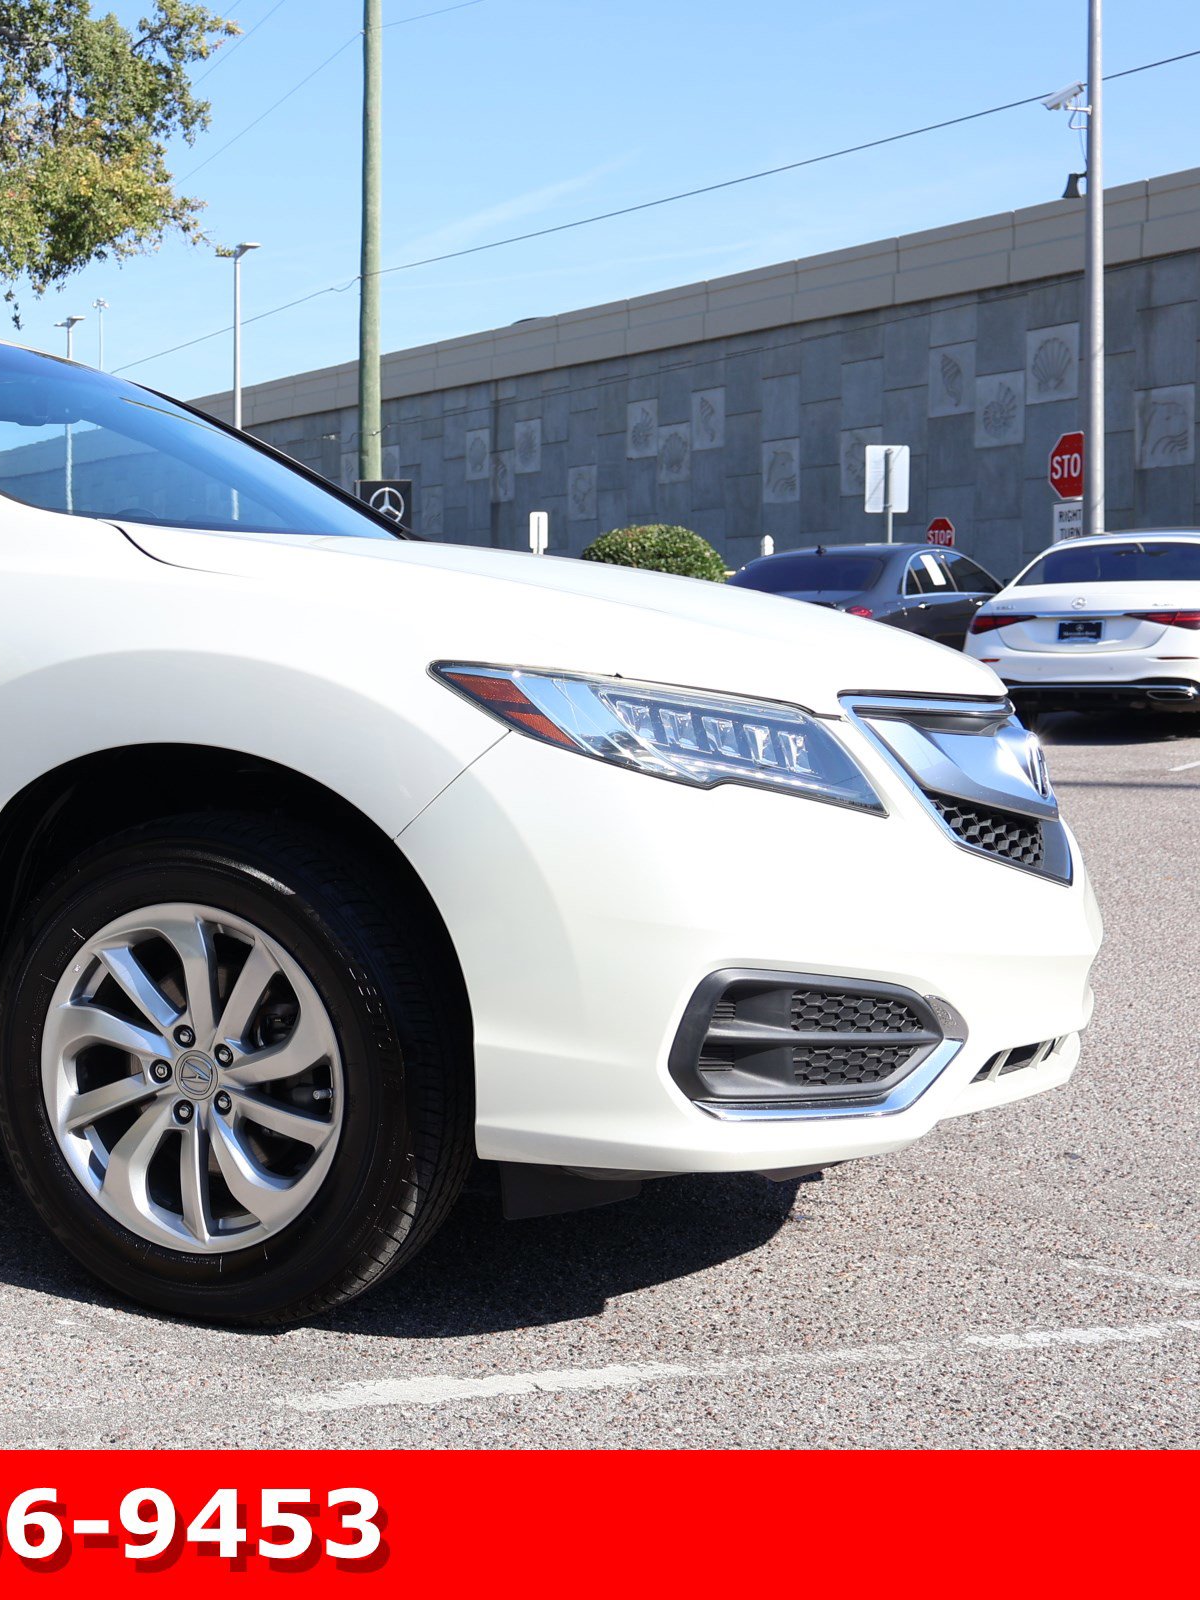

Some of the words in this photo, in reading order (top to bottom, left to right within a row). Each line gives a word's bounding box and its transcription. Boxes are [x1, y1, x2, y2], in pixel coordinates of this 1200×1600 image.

[1052, 453, 1081, 480] STO
[1058, 509, 1082, 523] RIGHT
[927, 530, 952, 545] STOP
